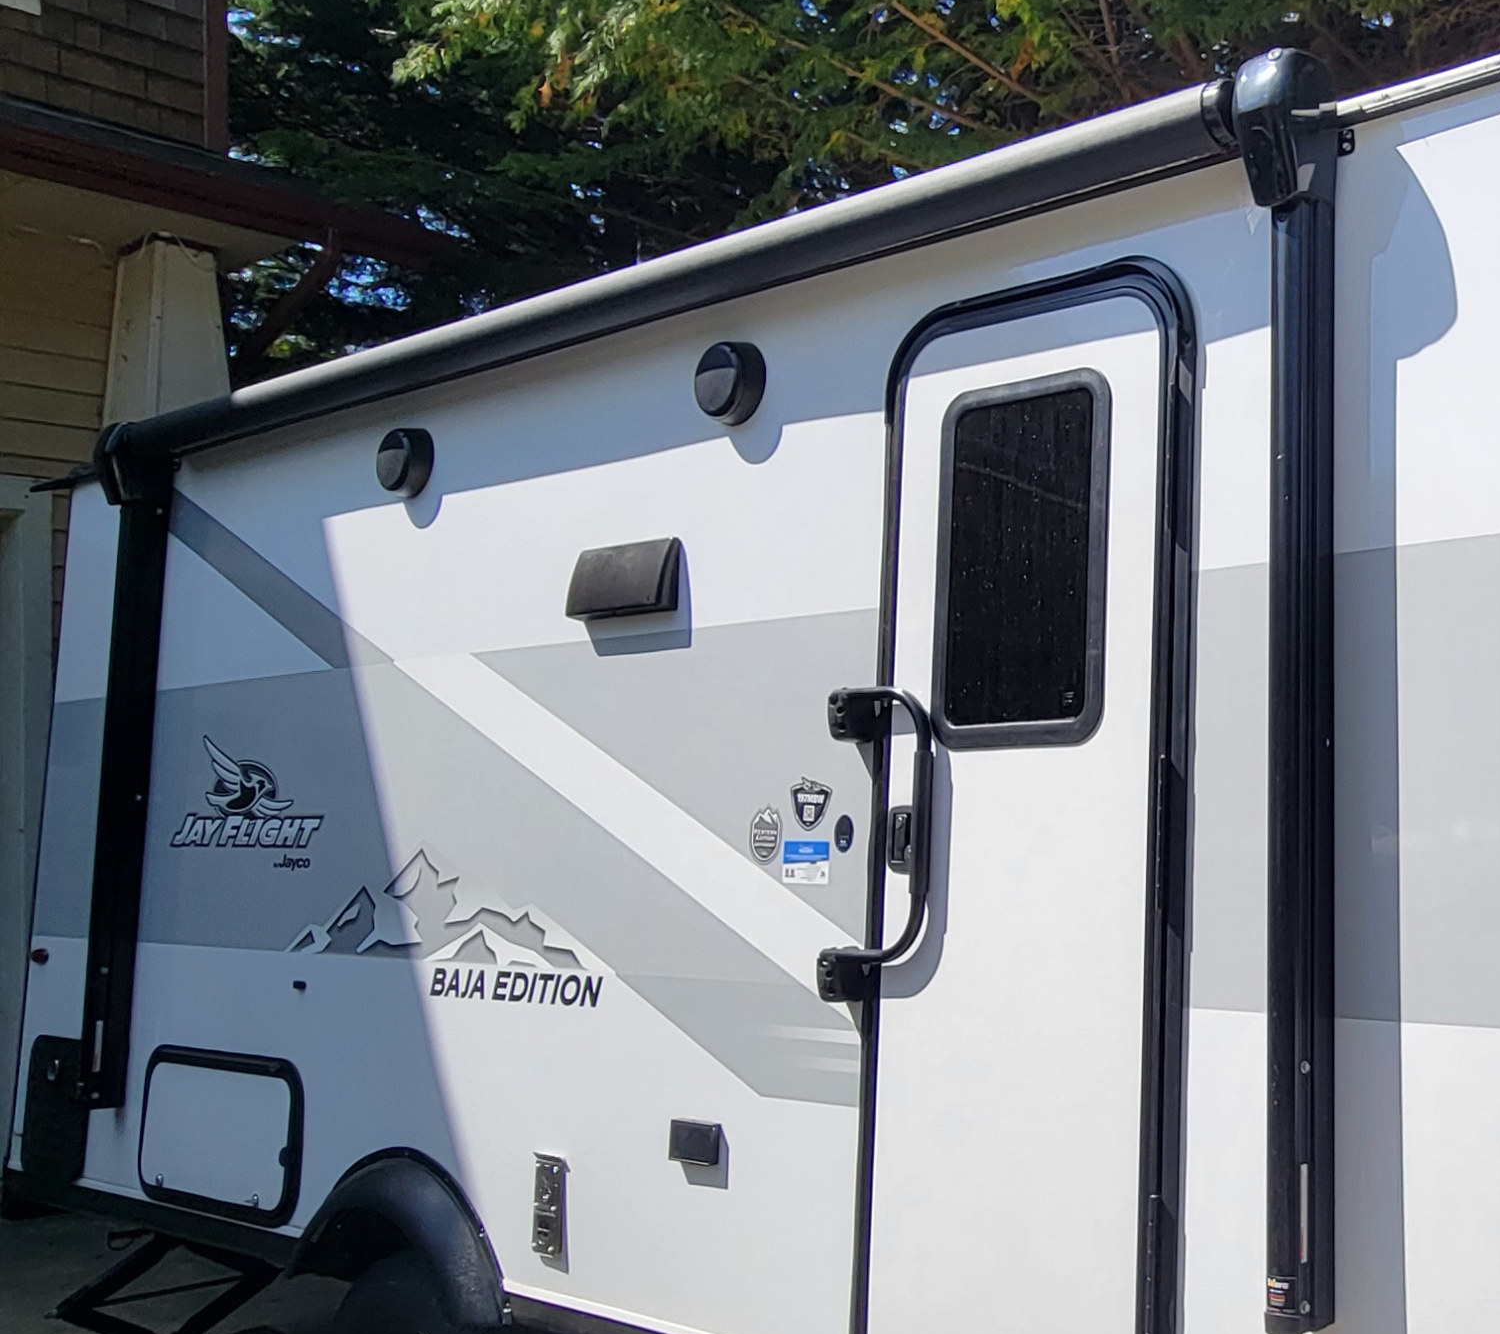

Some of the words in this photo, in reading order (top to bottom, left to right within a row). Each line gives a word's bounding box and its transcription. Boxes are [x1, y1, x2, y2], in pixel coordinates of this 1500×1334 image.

[279, 854, 311, 871] Jayco
[430, 967, 485, 1000] BAJA
[491, 970, 604, 1008] EDITION
